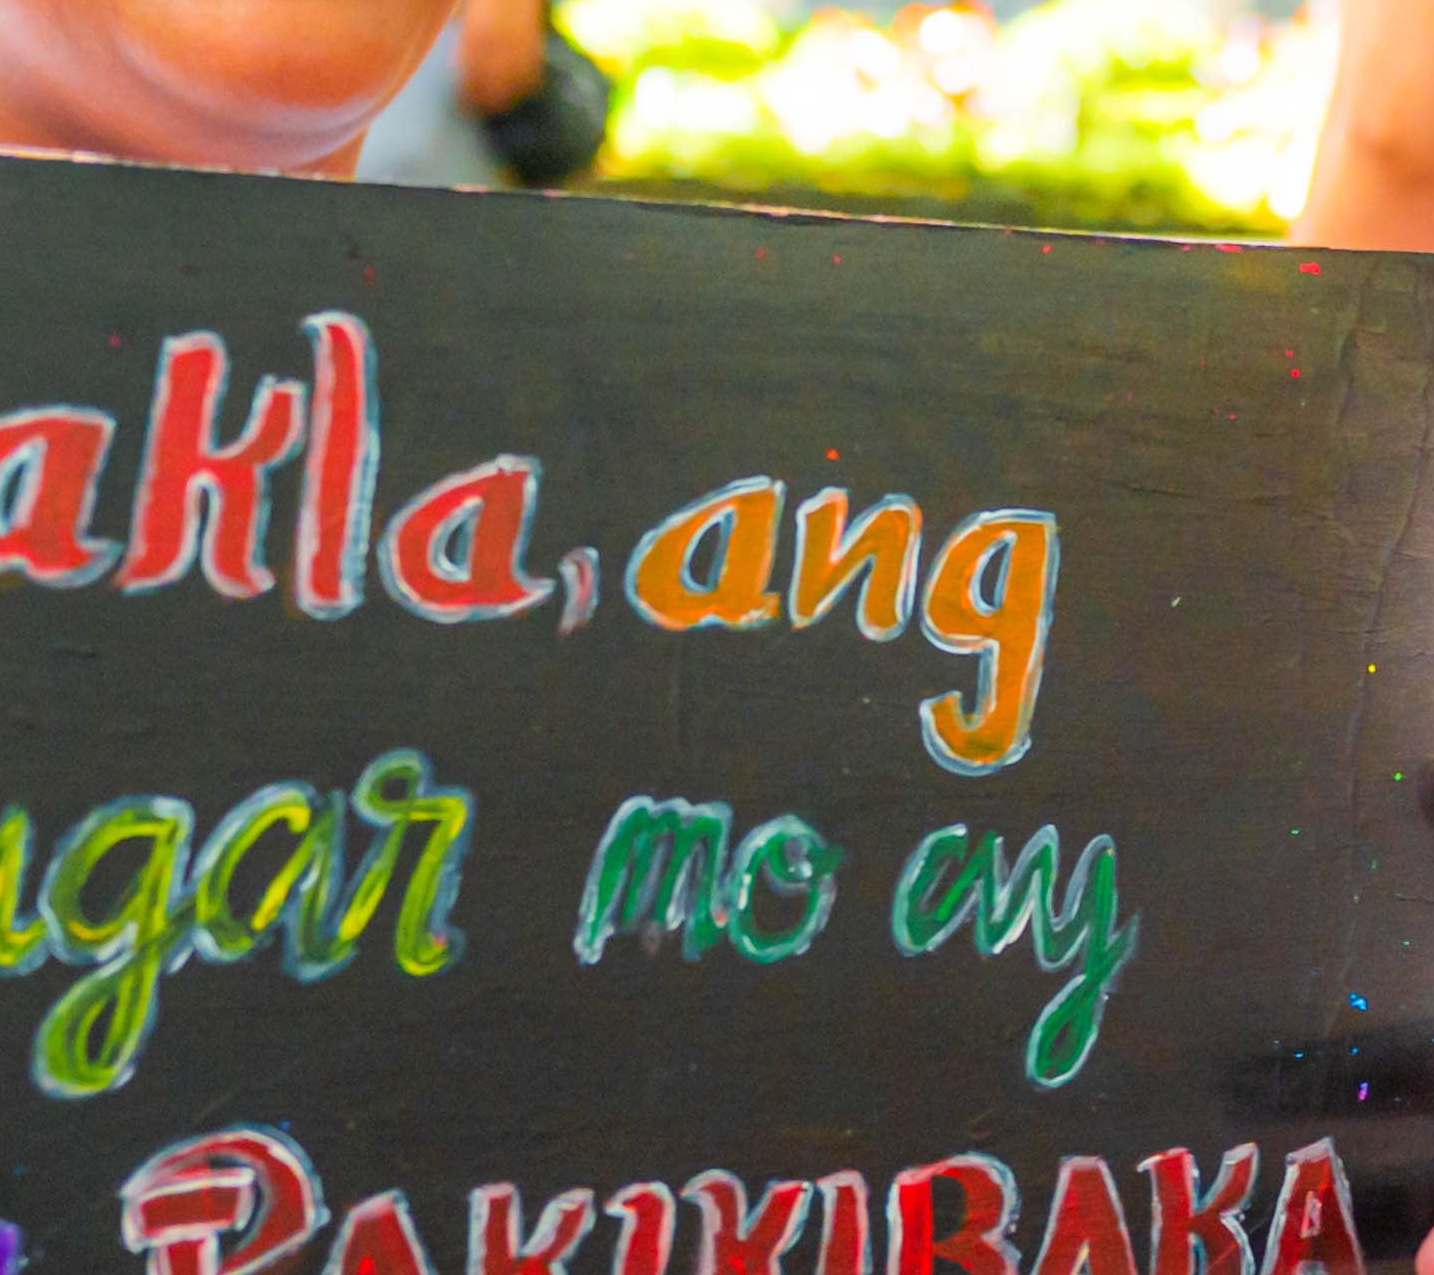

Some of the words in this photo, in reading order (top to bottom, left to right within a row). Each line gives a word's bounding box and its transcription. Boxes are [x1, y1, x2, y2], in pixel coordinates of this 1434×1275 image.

[624, 474, 1060, 777] ang
[572, 794, 846, 966] mo
[890, 820, 1139, 1089] ay
